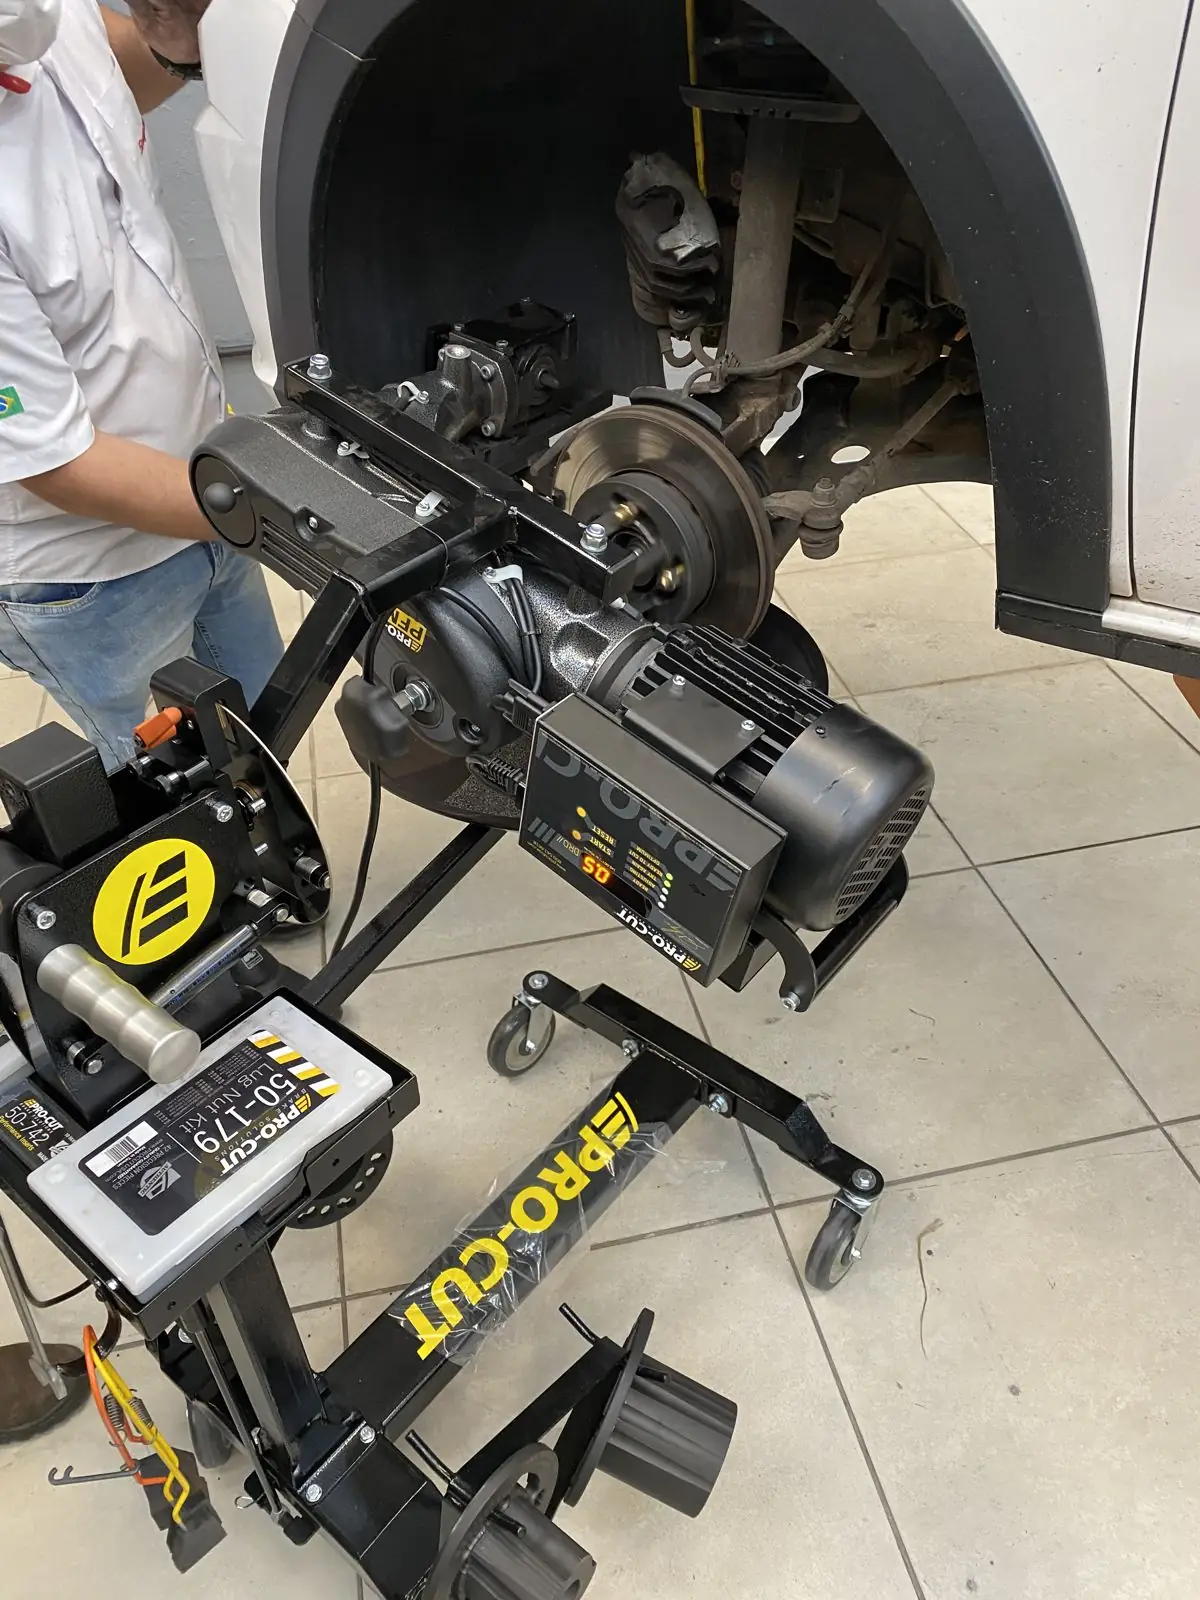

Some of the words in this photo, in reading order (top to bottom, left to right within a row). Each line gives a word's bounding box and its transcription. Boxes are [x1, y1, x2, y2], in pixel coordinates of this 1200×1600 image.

[589, 836, 612, 856] START
[591, 825, 614, 845] RESET
[582, 856, 610, 884] 0.5
[616, 907, 687, 964] PRO-CUT
[237, 1062, 275, 1089] Lug
[193, 1073, 297, 1154] 50-179
[205, 1087, 242, 1114] Nut
[276, 1087, 307, 1114] BRAKE
[5, 1105, 50, 1147] 50-742
[30, 1101, 64, 1131] PRO-CUT
[178, 1112, 208, 1134] Kit
[214, 1116, 271, 1161] SOLUTIONS
[220, 1102, 301, 1175] PRO-CUT
[133, 1150, 164, 1175] PRECISION
[112, 1172, 135, 1190] PIECES
[404, 1124, 616, 1360] PRO-CUT
